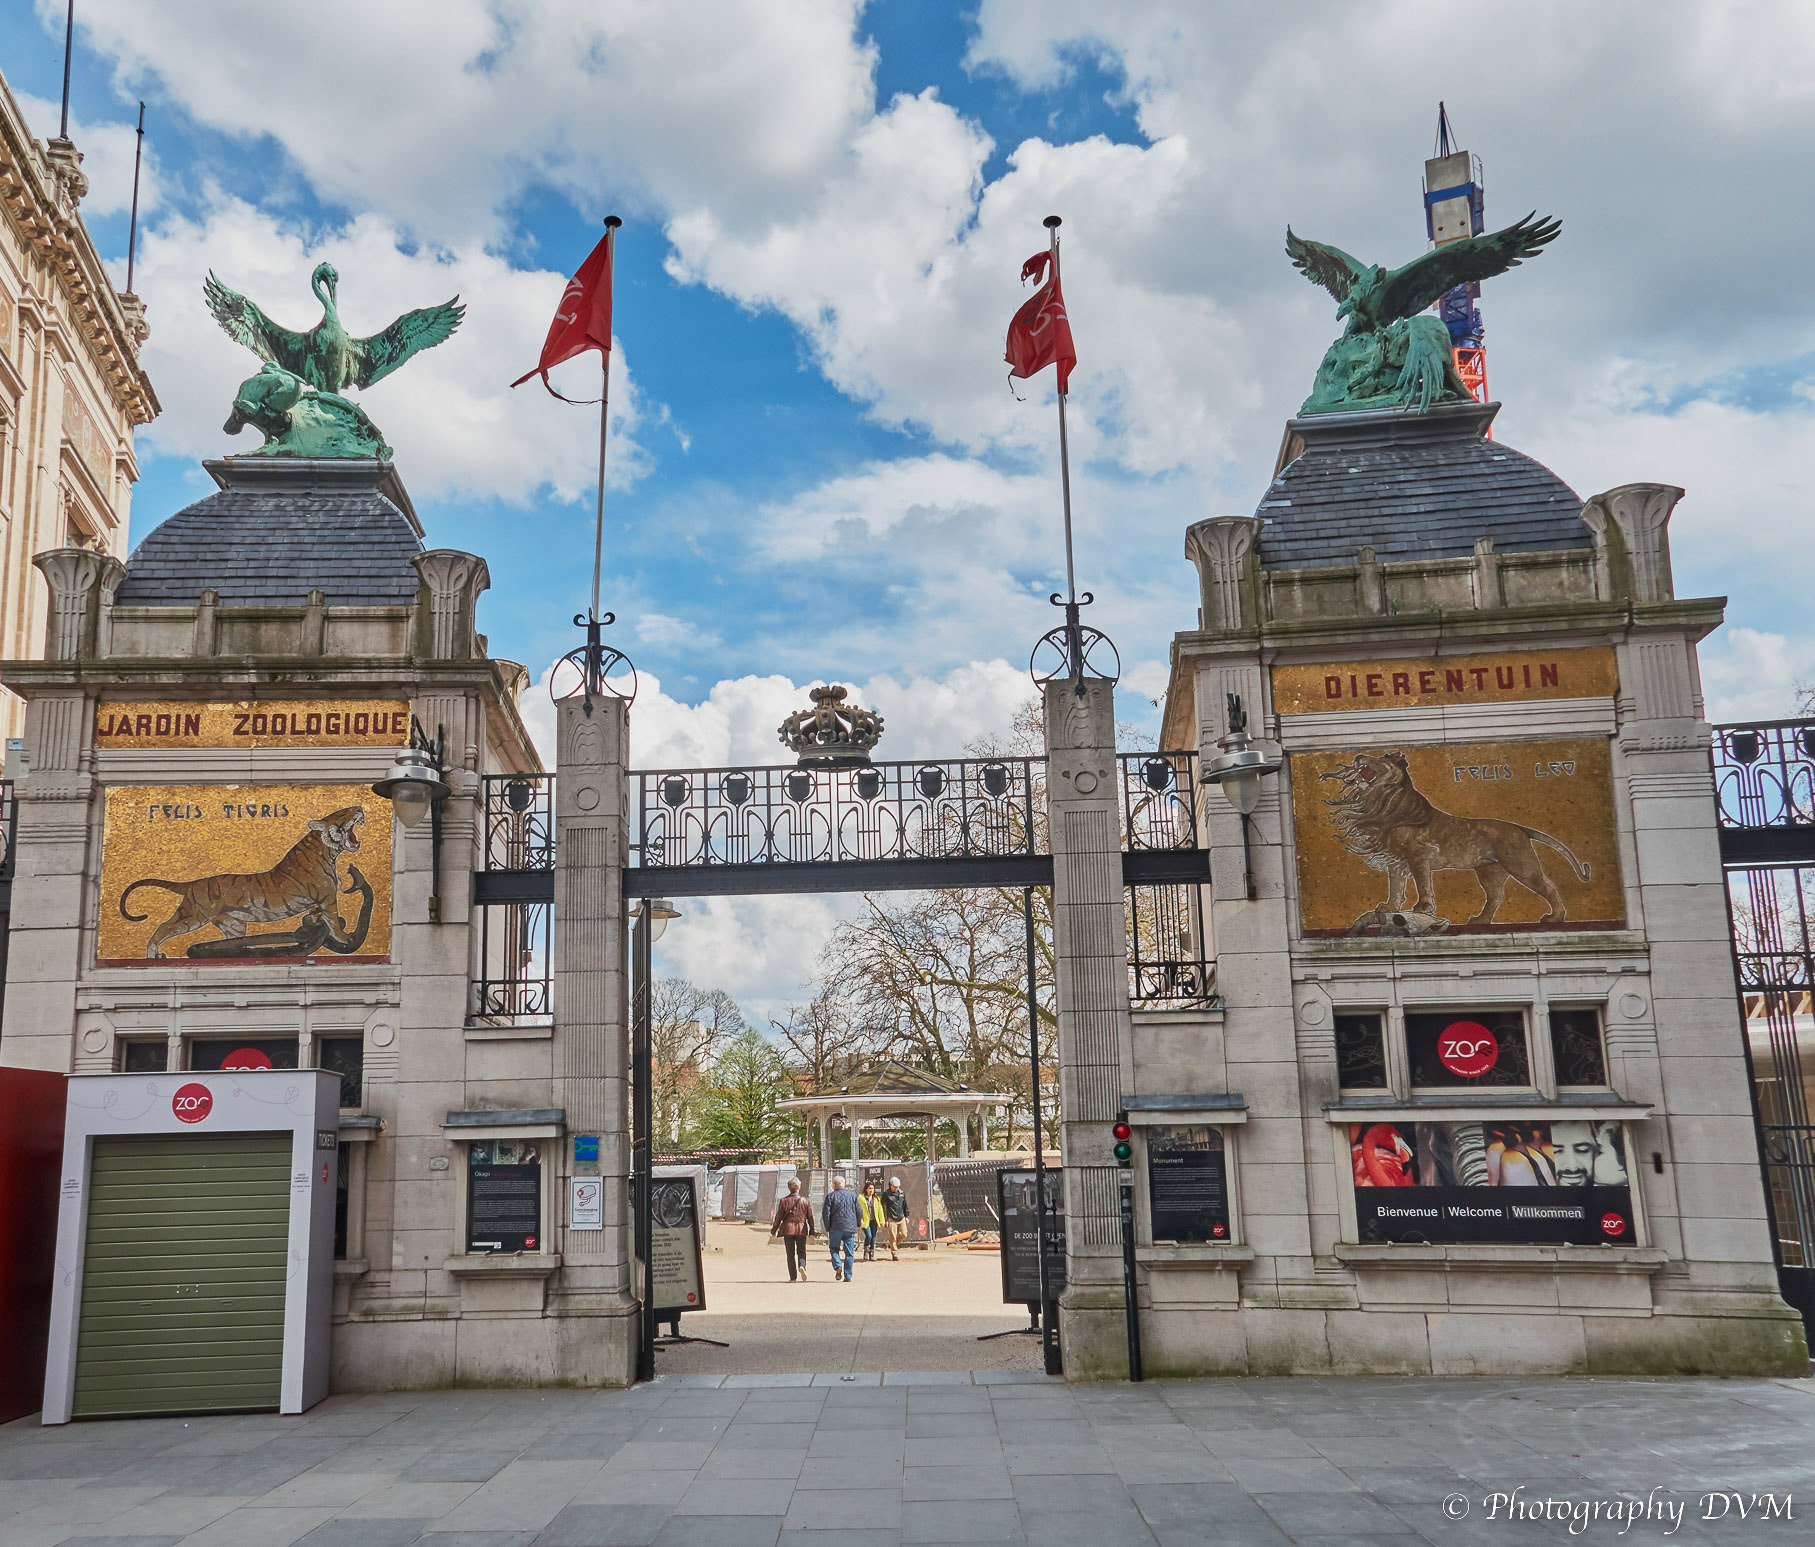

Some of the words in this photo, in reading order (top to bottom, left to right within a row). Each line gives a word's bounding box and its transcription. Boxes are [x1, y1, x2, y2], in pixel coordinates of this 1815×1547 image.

[1325, 663, 1559, 699] DIERENTUIN
[98, 714, 200, 737] JARDIN
[233, 712, 408, 736] ZOOLOGIQUE
[1454, 765, 1513, 782] FELIS
[1535, 761, 1576, 777] LEO
[149, 805, 203, 819] FELIS
[223, 803, 290, 819] TIGRIS
[318, 1133, 335, 1147] TICKETS
[1377, 1206, 1438, 1218] Bienvenue
[1448, 1206, 1502, 1218] Welcome
[1512, 1206, 1582, 1219] Willkommen
